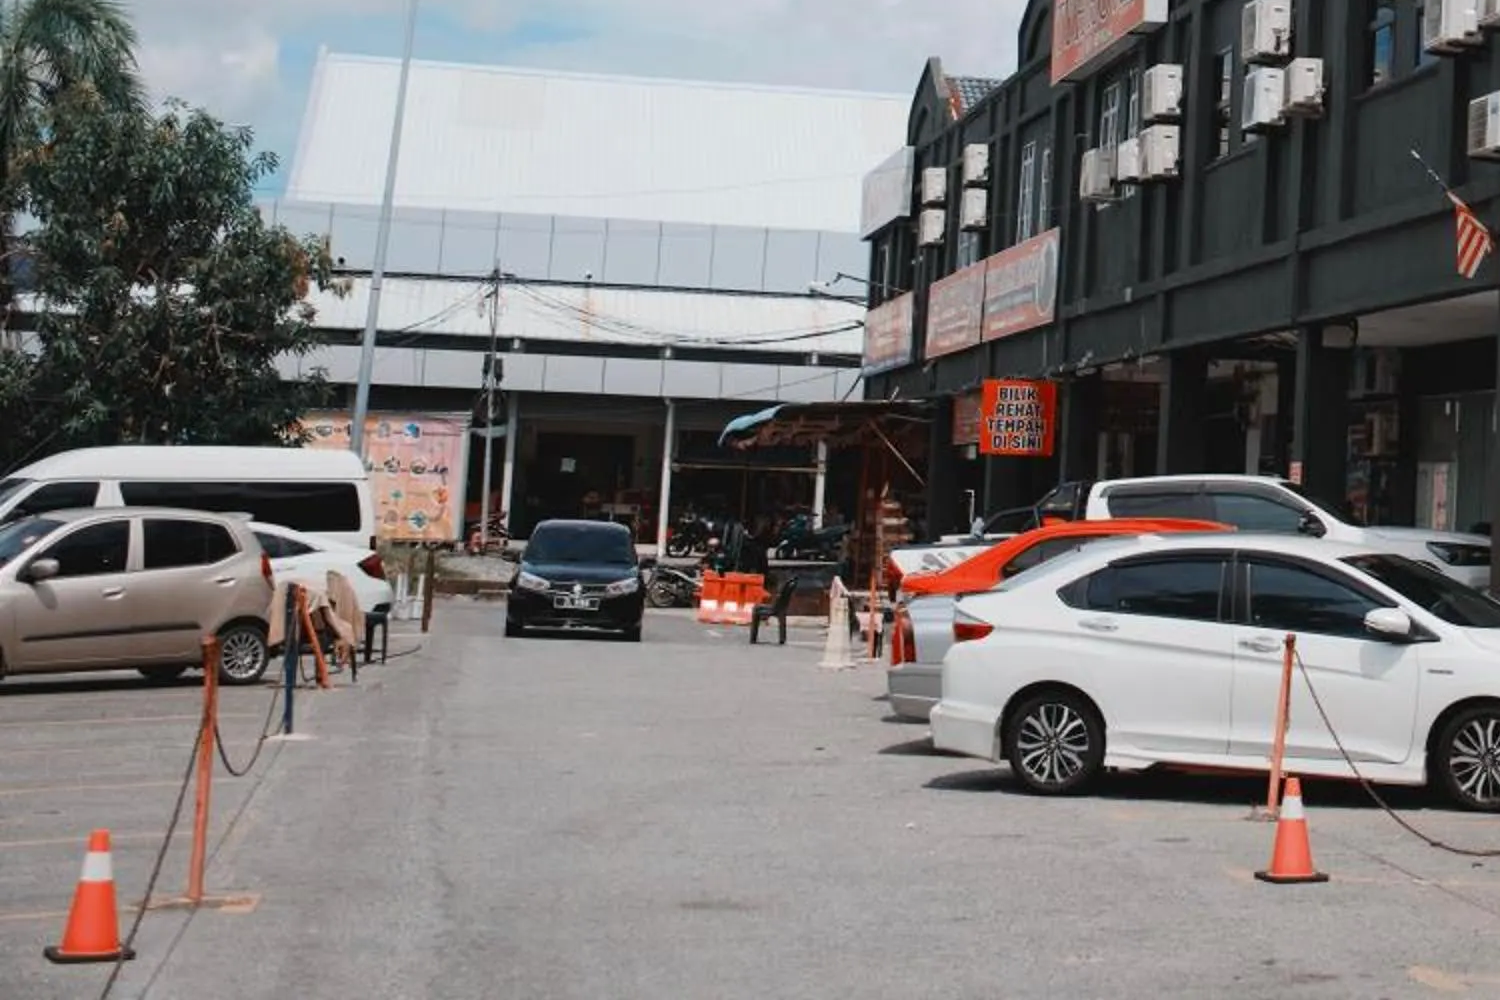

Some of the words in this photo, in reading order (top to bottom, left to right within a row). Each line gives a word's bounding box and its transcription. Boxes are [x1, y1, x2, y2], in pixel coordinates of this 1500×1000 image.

[999, 386, 1038, 401] BILIK
[996, 402, 1042, 417] REHAT
[988, 418, 1046, 433] TEMPAH
[993, 434, 1008, 449] DI
[1011, 434, 1043, 449] SINI
